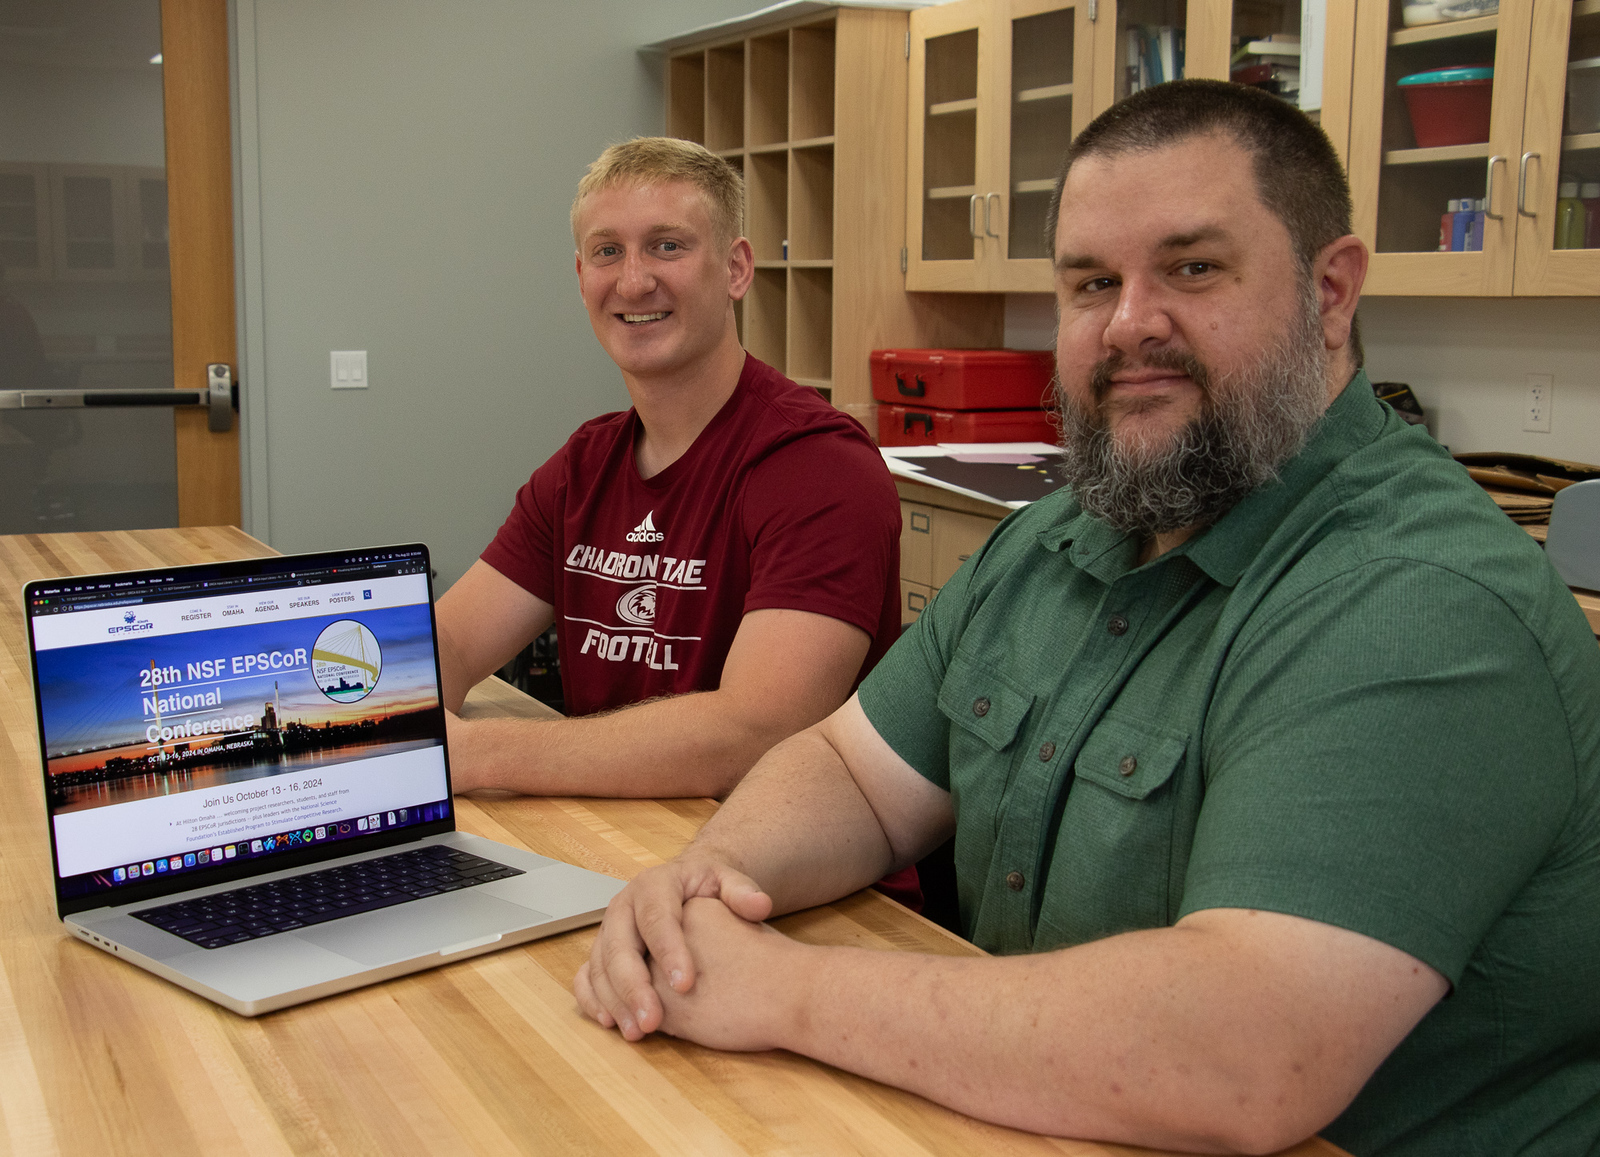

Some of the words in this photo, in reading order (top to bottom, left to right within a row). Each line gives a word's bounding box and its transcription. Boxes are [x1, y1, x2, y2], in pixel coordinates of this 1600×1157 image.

[626, 530, 664, 542] addas
[565, 544, 660, 579] CHADRON
[254, 604, 279, 613] AGENDA
[289, 599, 320, 609] SPEAKERS
[329, 595, 355, 604] POSTERS
[181, 612, 212, 621] REGISTER
[222, 608, 244, 616] OMAHA
[108, 622, 154, 634] EPSCoR
[580, 628, 679, 670] FOOTLL
[139, 665, 182, 687] 28th
[187, 658, 226, 681] NSF
[231, 648, 308, 675] EPSCoR
[316, 666, 326, 674] NSF
[327, 664, 346, 673] EPSCoR
[143, 687, 222, 715] National
[145, 714, 255, 743] Conference
[204, 745, 226, 754] OMAHA,
[226, 740, 254, 750] NEBRASKA
[203, 796, 221, 809] Join
[223, 793, 235, 805] Us
[236, 788, 269, 802] October
[271, 785, 281, 795] 13
[289, 782, 301, 792] 16,
[303, 778, 323, 790] 2024
[199, 814, 215, 822] Omaha
[224, 807, 249, 817] welcoming
[249, 804, 267, 814] project
[268, 799, 295, 809] researchers,
[297, 794, 317, 802] students,
[199, 823, 217, 831] EPSCoR
[217, 816, 246, 828] jurisdictions
[252, 813, 262, 821] plus
[263, 810, 280, 818] leaders
[300, 802, 319, 811] National
[320, 799, 337, 807] Science
[186, 831, 217, 842] Foundation's
[218, 826, 244, 836] Established
[245, 822, 265, 831] Program
[271, 816, 293, 825] Stimulate
[294, 811, 321, 821] Competitive
[322, 807, 343, 815] Research.
